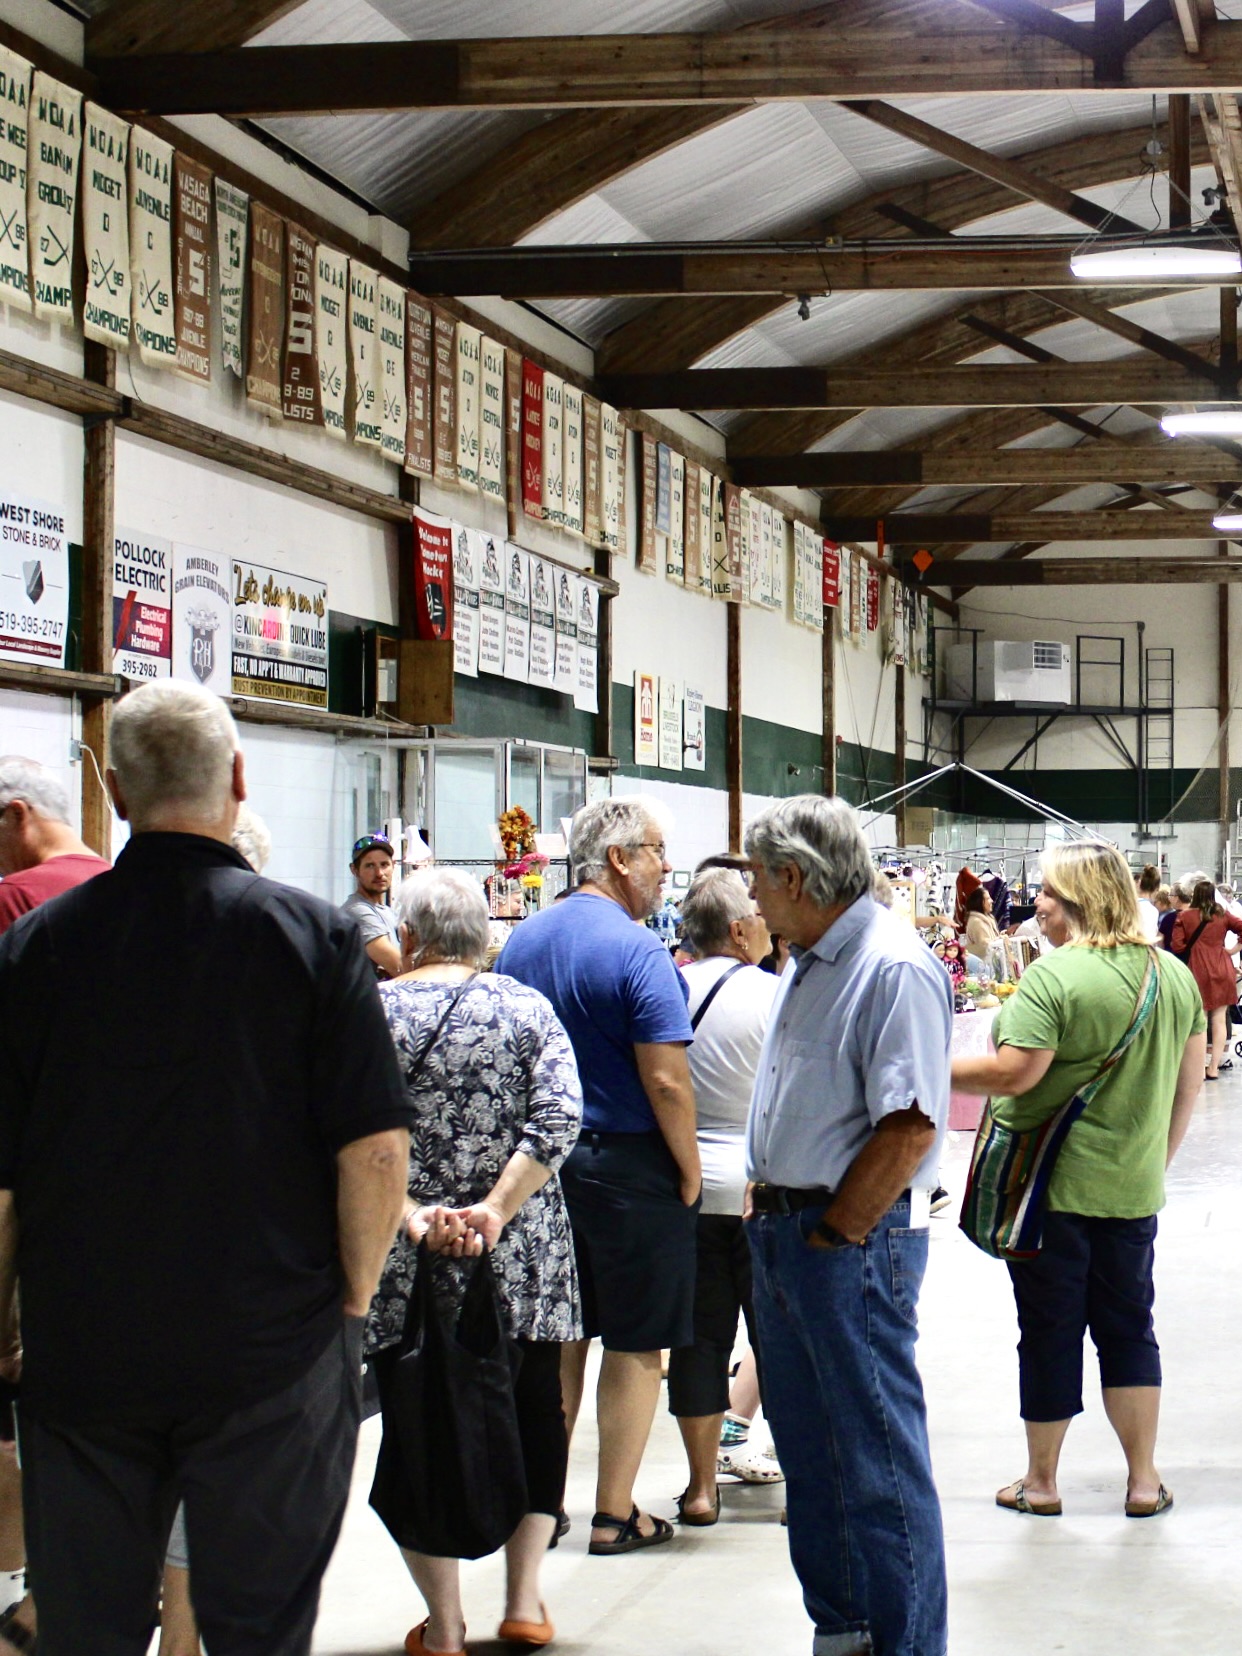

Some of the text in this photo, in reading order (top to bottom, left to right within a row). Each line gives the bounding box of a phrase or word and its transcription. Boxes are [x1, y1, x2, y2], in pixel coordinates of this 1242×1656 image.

[38, 96, 74, 138] WOAA
[89, 124, 124, 164] WOAA
[136, 147, 169, 185] WOAA
[92, 169, 122, 201] MIDGET
[135, 188, 170, 222] JUVENILE
[180, 193, 208, 225] BEACH
[319, 259, 344, 290] WOAA
[85, 301, 129, 337] CHAMPIONS
[283, 402, 315, 421] LISTS
[33, 510, 64, 533] SHORE
[2, 525, 61, 552] STONE & BRICK
[418, 526, 441, 546] Welcome
[115, 539, 165, 569] POLLOCK
[186, 558, 218, 577] AMBERLEY
[115, 563, 166, 593] ELECTRIC
[175, 575, 230, 604] GRAIN ELEVATORS
[0, 611, 63, 638] 519-395-2747
[141, 605, 167, 624] Electrical
[131, 634, 160, 652] Hardware
[135, 620, 164, 641] Plumbing
[290, 624, 310, 647] QUICK
[311, 628, 326, 651] LUBE
[122, 660, 157, 677] 395-2982
[233, 656, 249, 677] FAST,
[279, 663, 304, 683] WARRANTY
[233, 678, 249, 693] RUST
[250, 681, 285, 699] PREVENTION
[293, 688, 326, 705] APPOINTMENT
